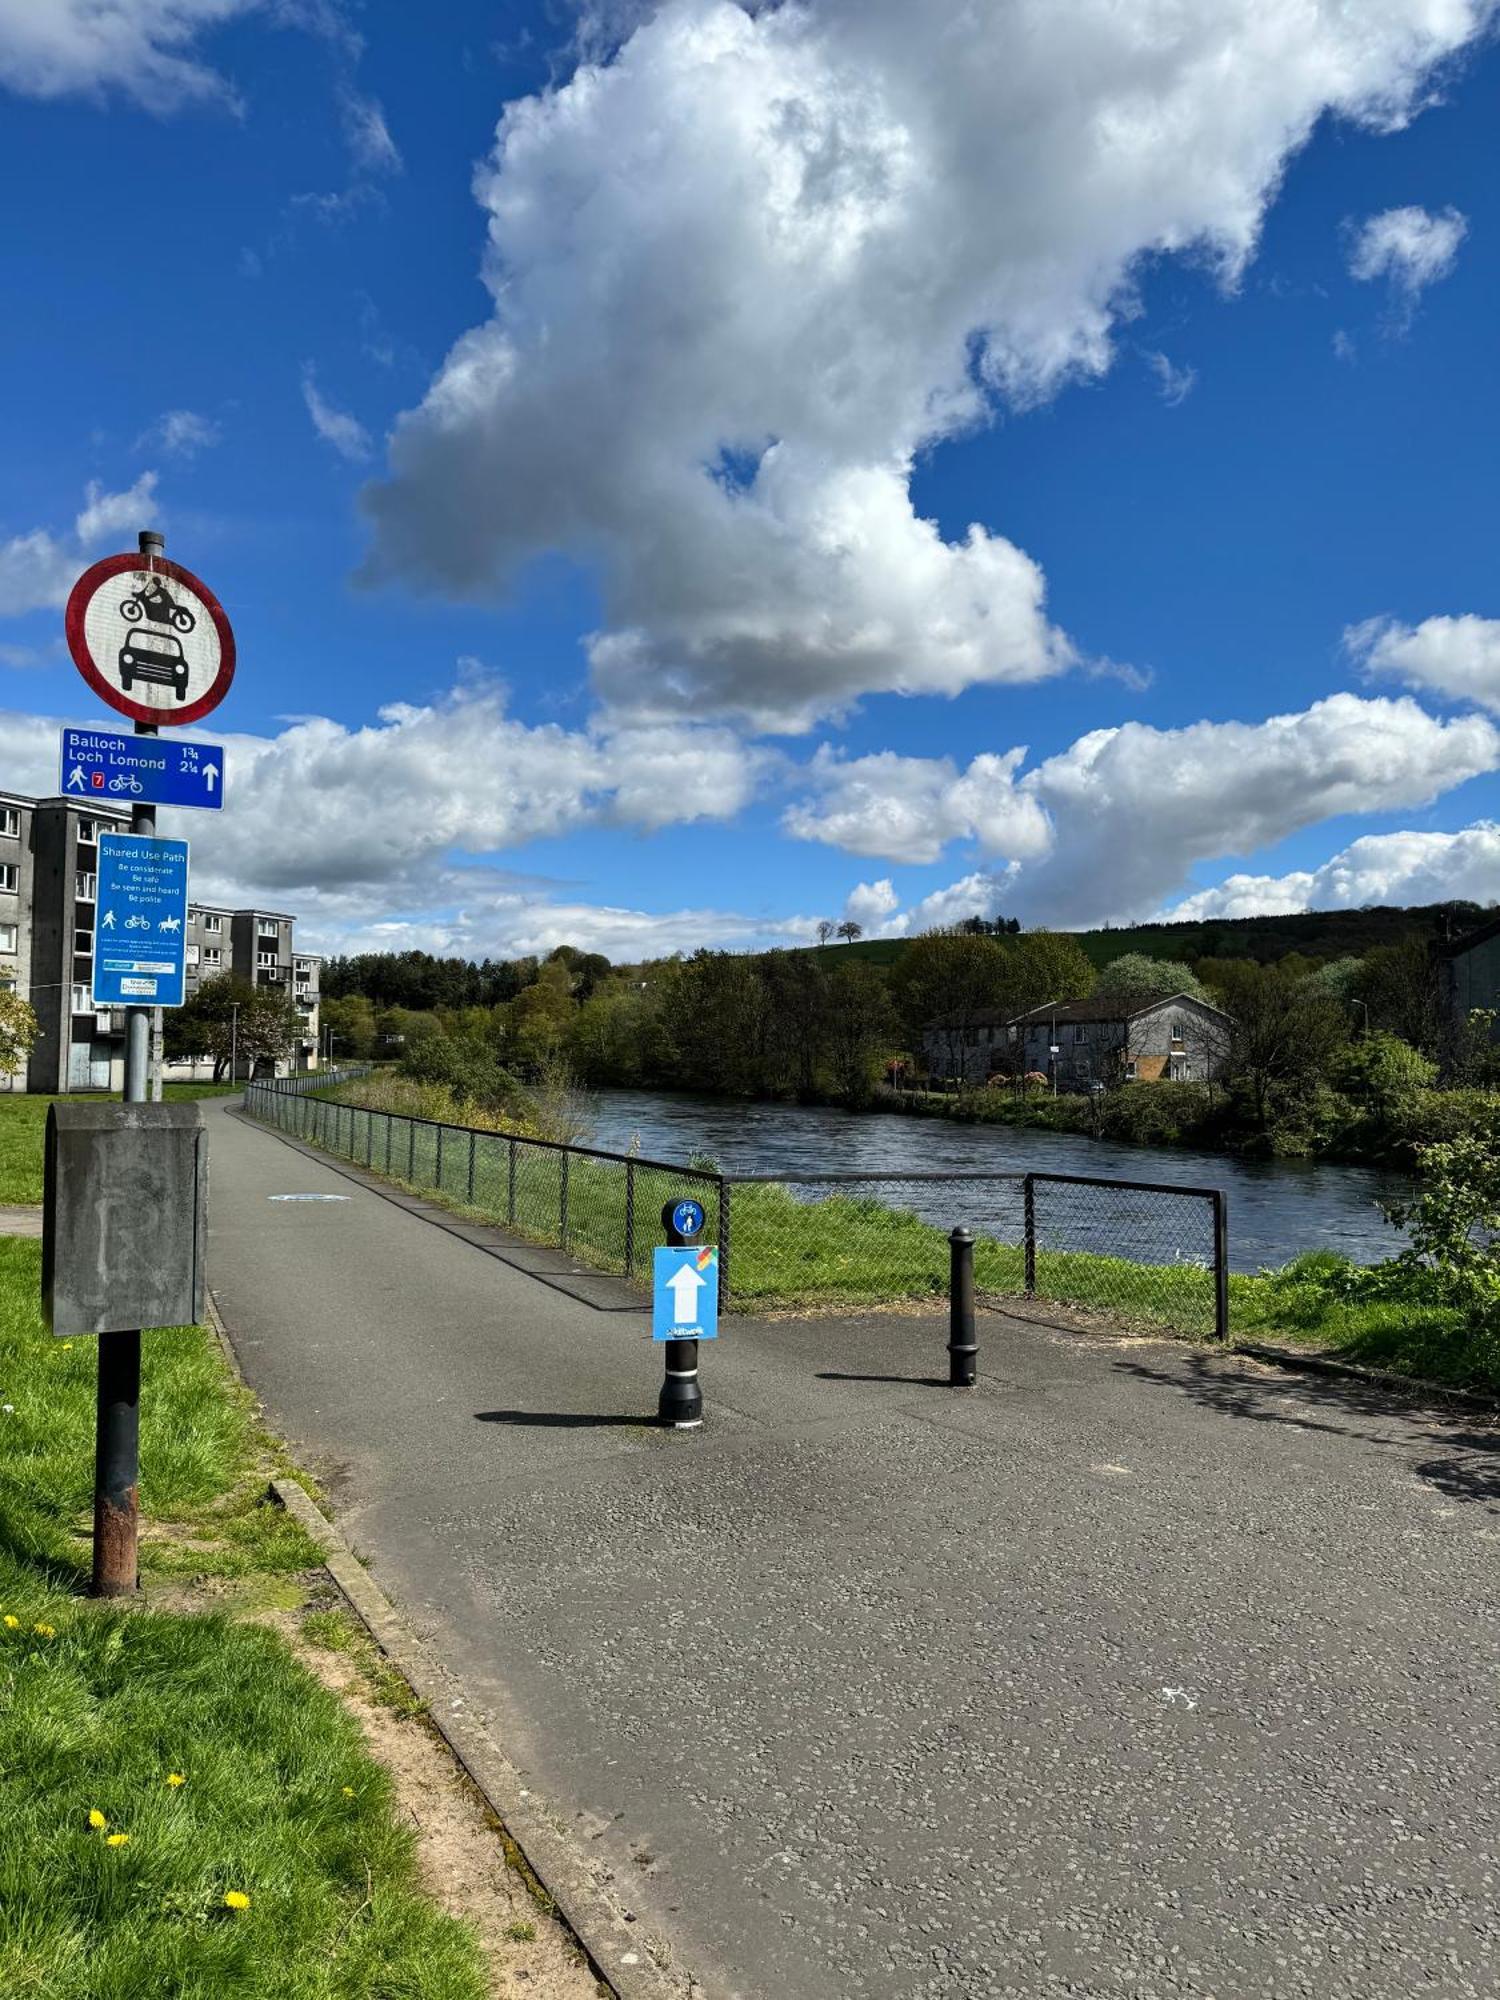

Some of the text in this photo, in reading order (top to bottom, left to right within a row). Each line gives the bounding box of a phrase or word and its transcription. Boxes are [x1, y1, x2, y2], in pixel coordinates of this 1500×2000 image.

[69, 733, 126, 751] Balloch
[69, 748, 104, 763] Loch
[109, 753, 166, 770] Lomond
[95, 775, 102, 785] 7
[102, 846, 185, 862] Shared Use Path
[118, 863, 173, 875] Be considerate
[132, 874, 142, 882] Be
[158, 887, 179, 895] heard
[128, 894, 138, 902] Be
